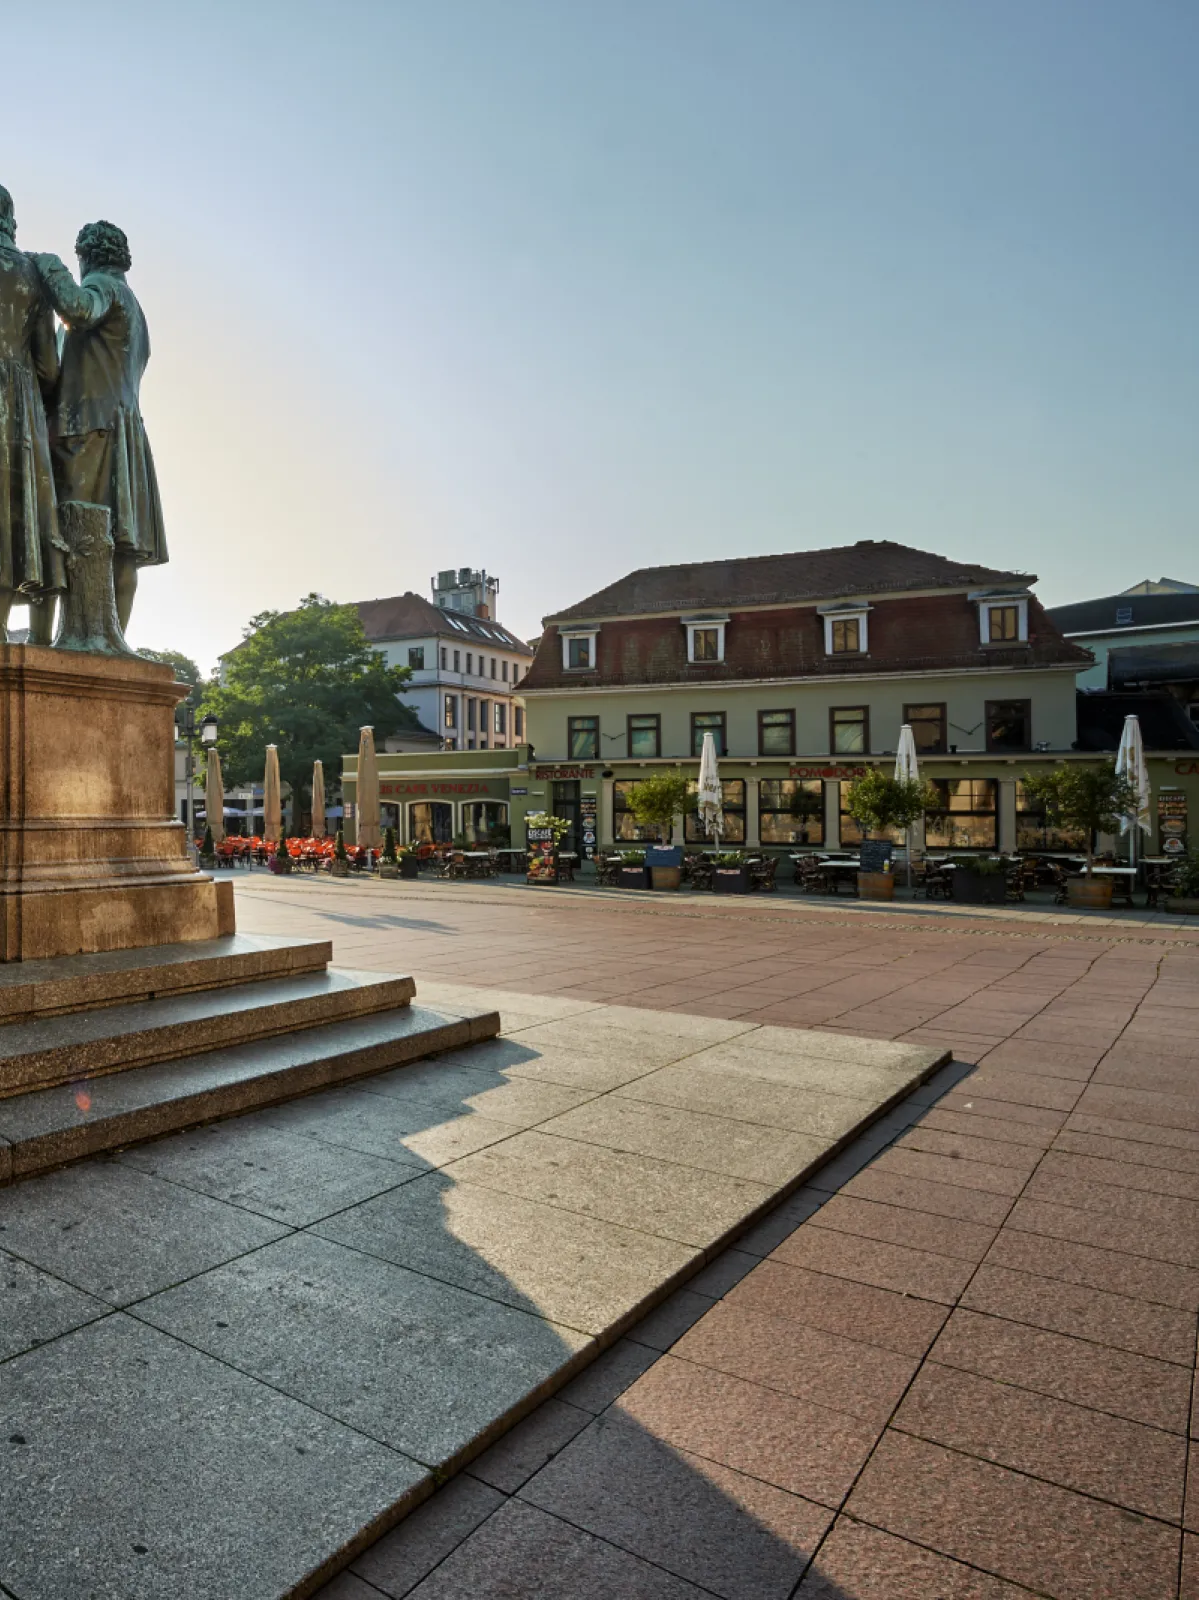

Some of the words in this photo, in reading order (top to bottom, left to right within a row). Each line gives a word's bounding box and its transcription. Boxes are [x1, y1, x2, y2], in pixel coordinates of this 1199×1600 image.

[536, 768, 595, 780] RISTORANTE
[789, 767, 867, 778] POMODOR
[431, 783, 489, 794] VENEZIA
